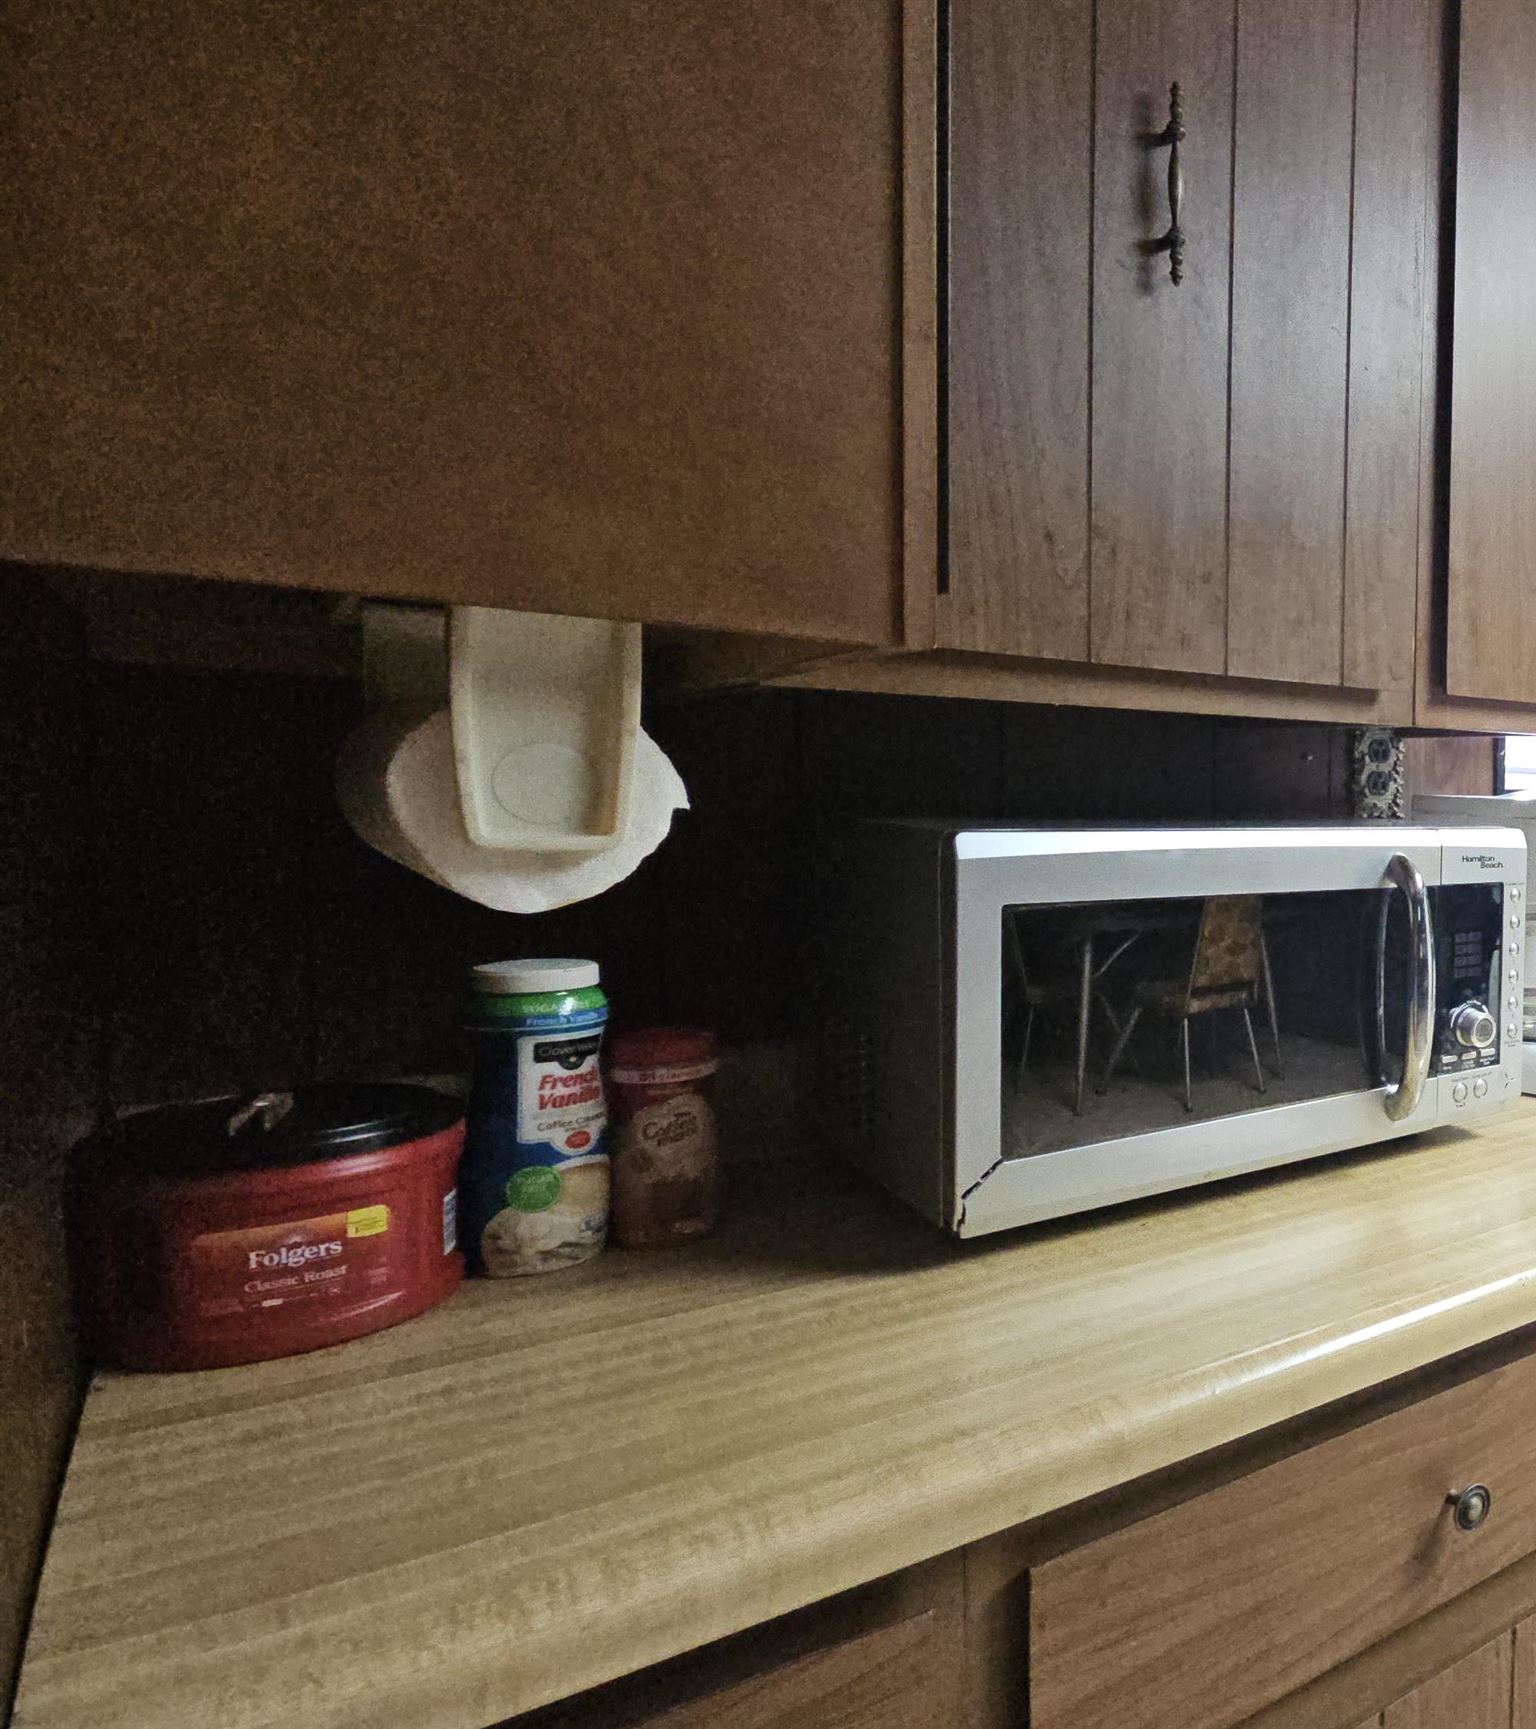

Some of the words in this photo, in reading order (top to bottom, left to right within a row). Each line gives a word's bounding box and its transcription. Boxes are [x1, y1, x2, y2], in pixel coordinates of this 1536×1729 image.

[1462, 855, 1495, 863] Hamilton
[1480, 861, 1504, 869] Beach
[536, 1119, 574, 1132] Coffee
[249, 1240, 343, 1269] Folgers
[244, 1274, 300, 1294] Classic
[303, 1264, 349, 1283] Roast
